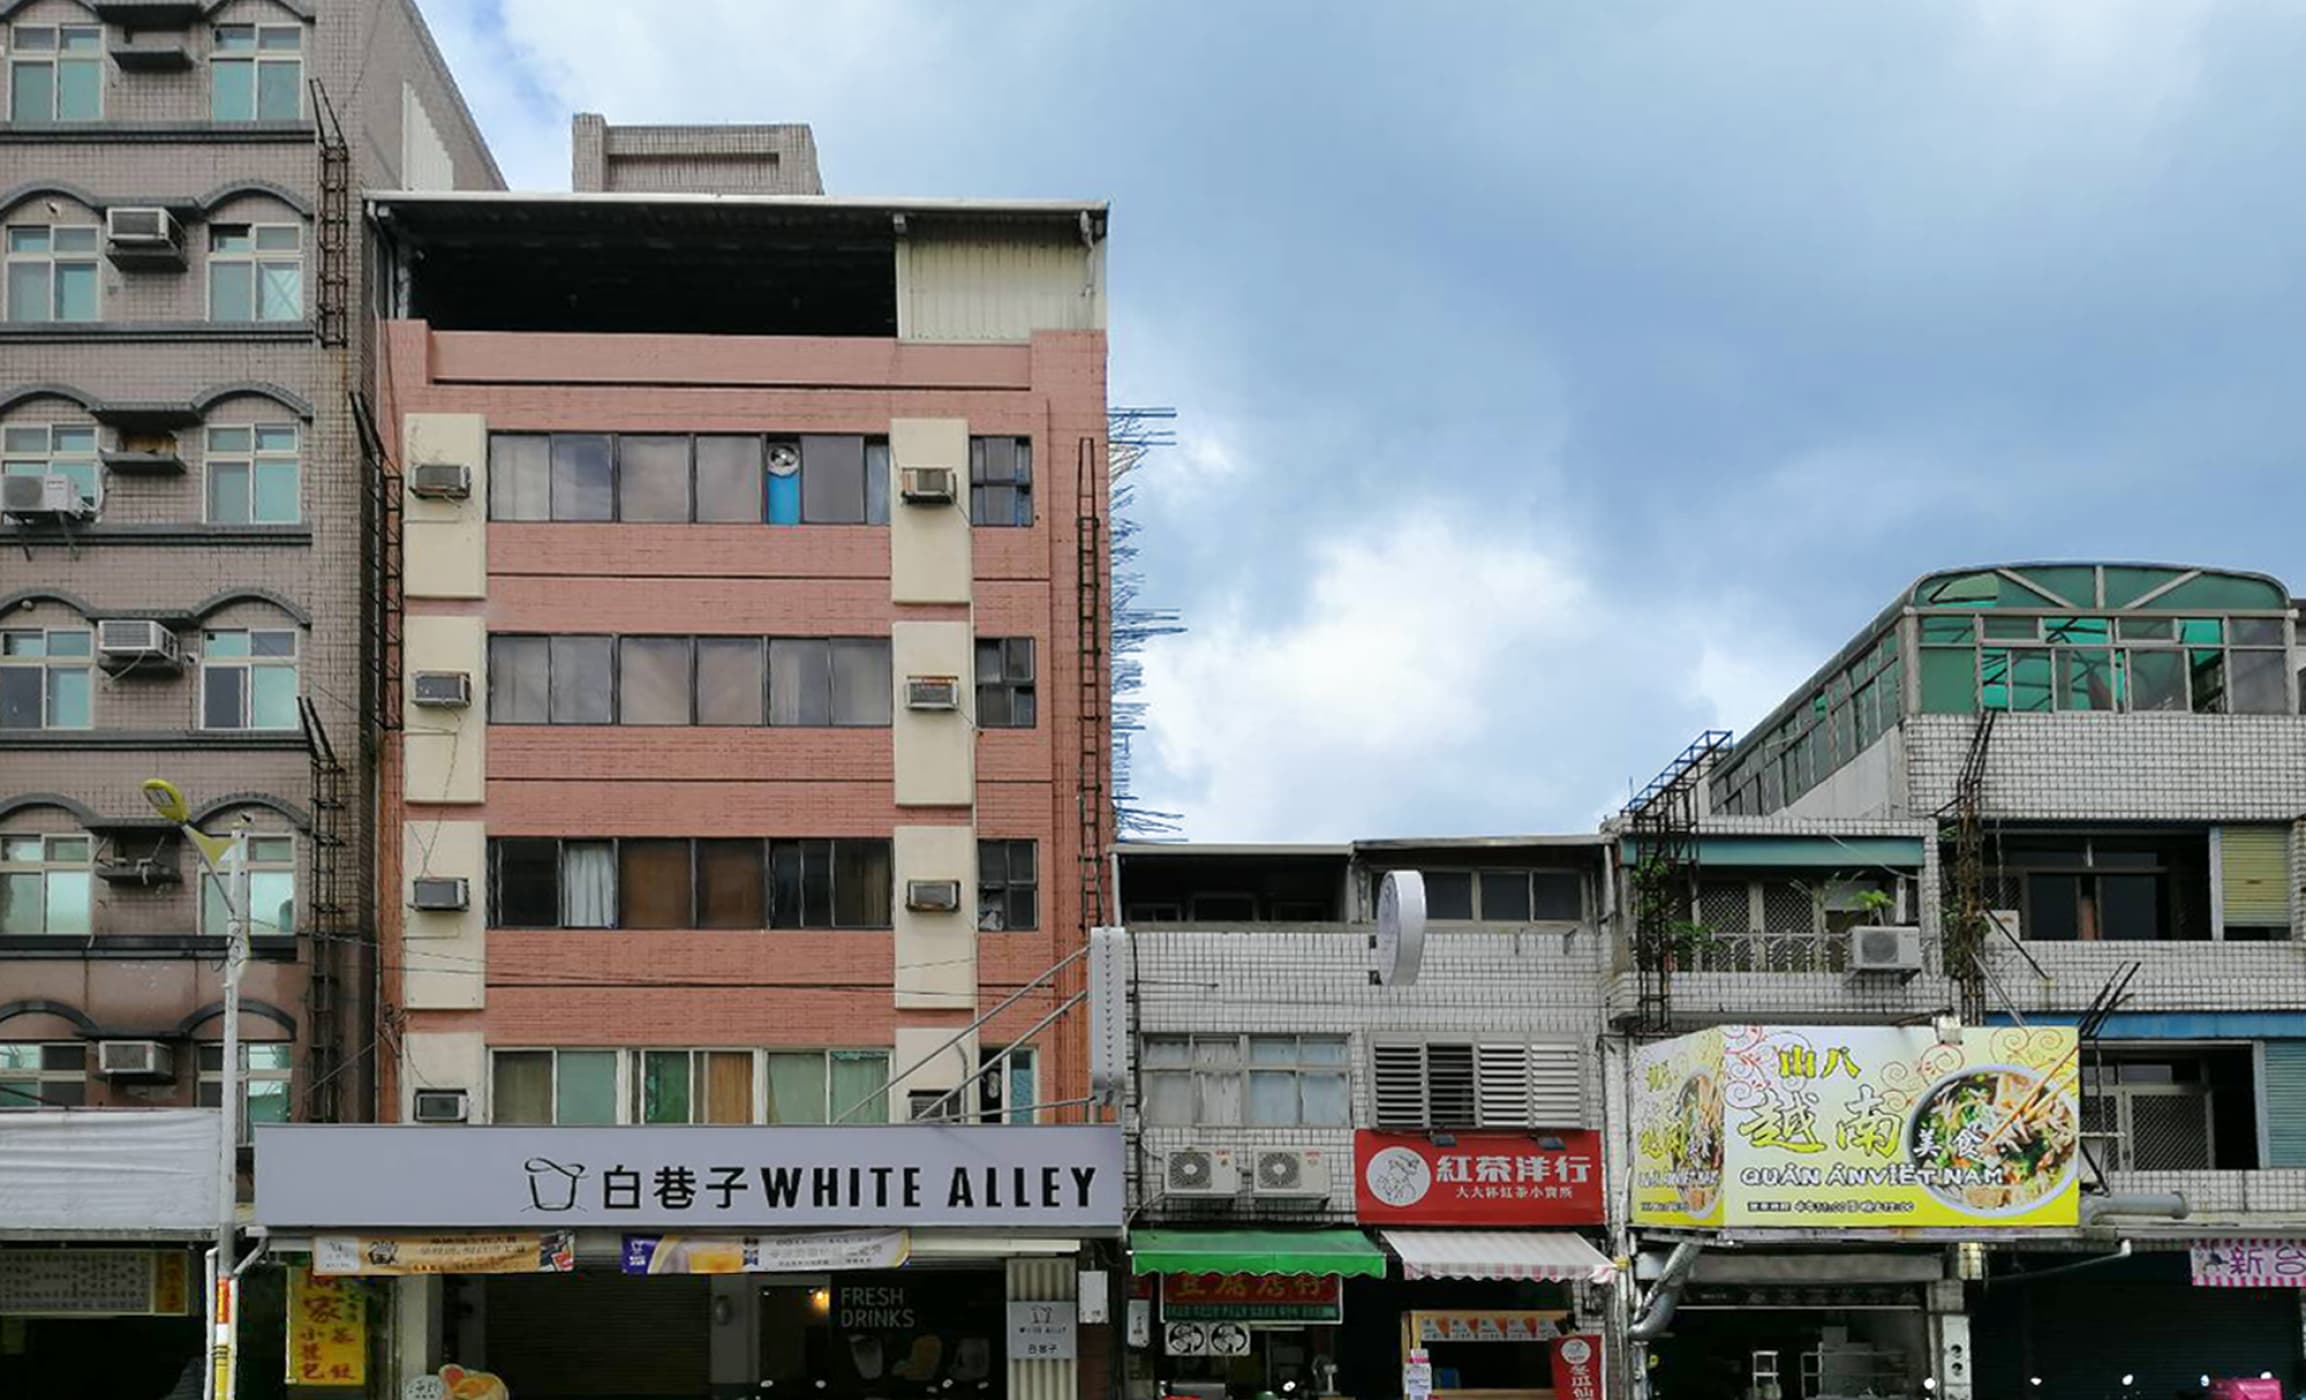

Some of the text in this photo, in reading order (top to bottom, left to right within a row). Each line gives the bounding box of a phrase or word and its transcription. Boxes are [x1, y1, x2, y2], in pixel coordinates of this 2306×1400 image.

[1738, 1083, 1903, 1159] 越南
[1912, 1122, 1985, 1159] 美食
[1436, 1155, 1592, 1183] 紅茶洋行
[1942, 1167, 2003, 1187] NAM
[602, 1164, 1098, 1211] 白巷子 WHITE ALLEY
[841, 1287, 905, 1305] FRESH
[841, 1309, 915, 1328] DRINKS
